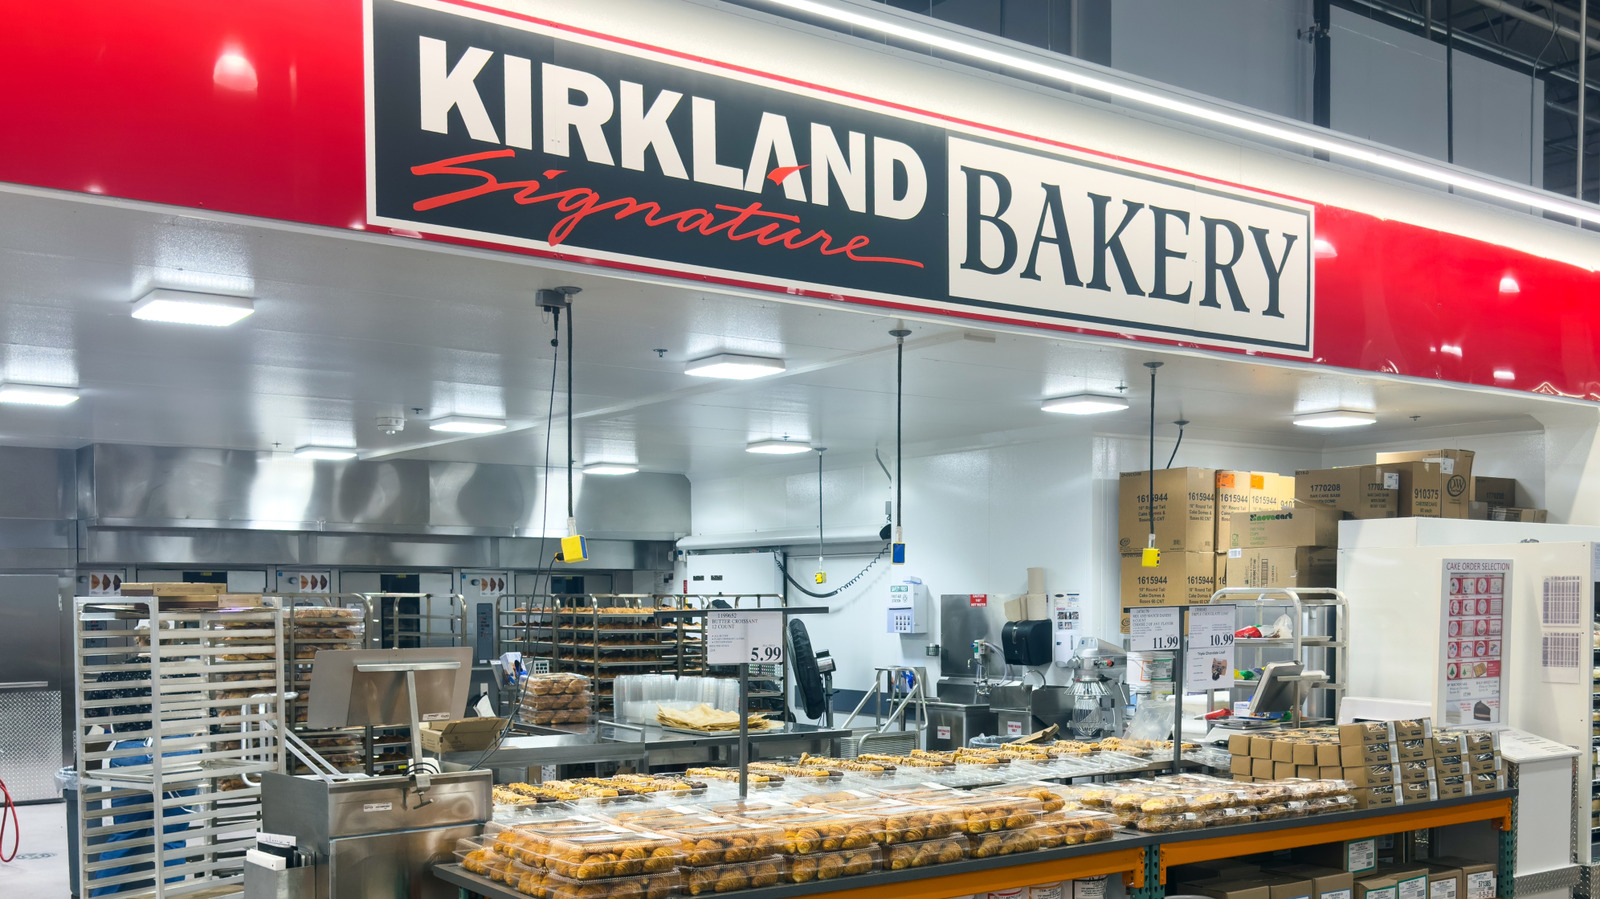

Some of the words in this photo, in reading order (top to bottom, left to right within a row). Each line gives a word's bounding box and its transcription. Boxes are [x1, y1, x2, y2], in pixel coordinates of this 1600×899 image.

[419, 36, 928, 220] KIRKLAND
[410, 149, 924, 268] Signature
[960, 165, 1298, 319] BAKERY
[1310, 484, 1341, 492] 1770208
[1188, 492, 1214, 502] 1615944
[1220, 494, 1248, 503] 1615944
[1414, 488, 1439, 500] 910375
[1252, 496, 1277, 505] 1615944
[1257, 512, 1293, 520] novacart
[1446, 562, 1460, 570] CAKE
[1462, 562, 1480, 570] ORDER
[1482, 562, 1510, 570] SELECTION
[1138, 576, 1168, 584] 1615944
[1187, 576, 1214, 584] 1615944
[1153, 636, 1178, 648] 11.99
[1210, 634, 1234, 646] 10.99
[750, 647, 782, 662] 5.99
